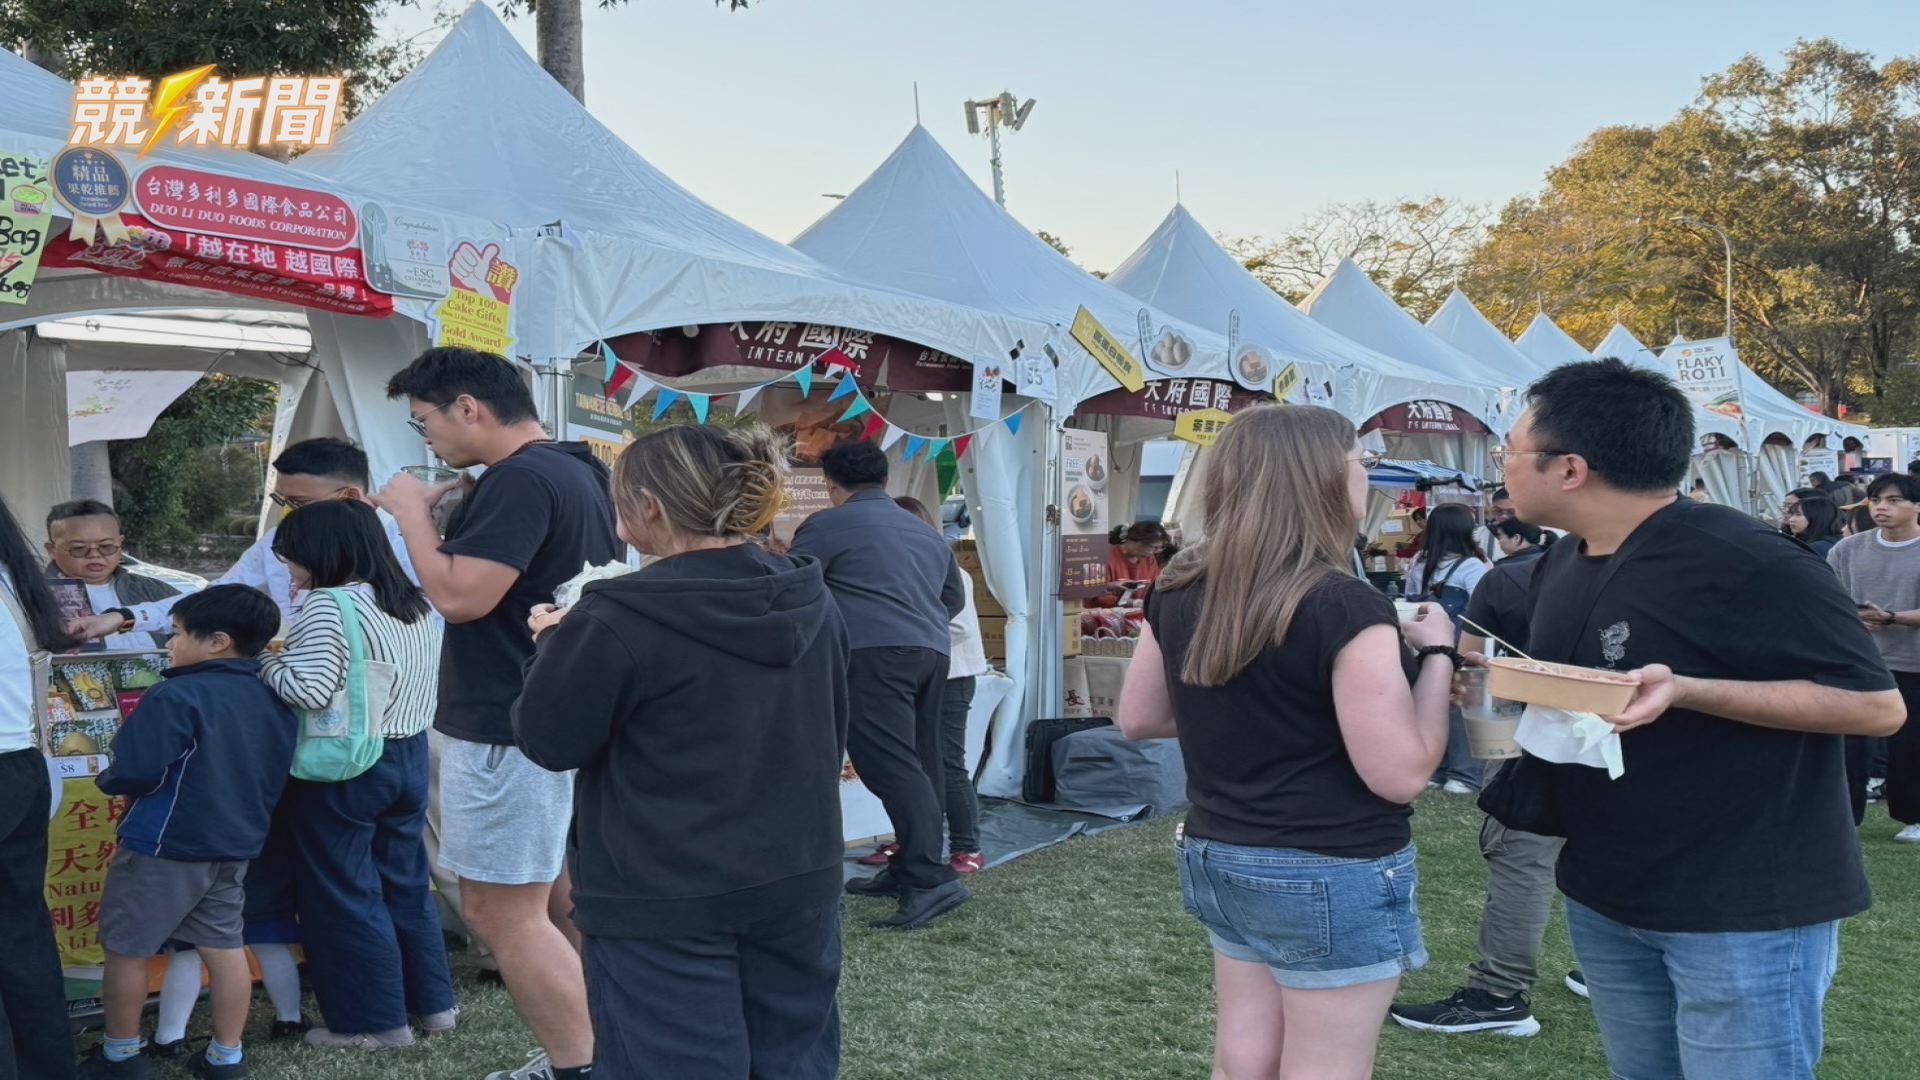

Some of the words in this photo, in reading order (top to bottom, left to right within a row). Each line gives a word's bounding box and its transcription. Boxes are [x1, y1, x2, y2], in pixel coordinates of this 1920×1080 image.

[72, 165, 110, 182] 精品
[146, 176, 348, 226] 台灣多利多國際食品公司
[150, 203, 177, 217] DUO
[181, 207, 193, 218] LI
[198, 210, 225, 223] DUO
[229, 214, 266, 229] FOODS
[270, 221, 347, 241] CORPORATION
[455, 288, 476, 306] Top
[479, 297, 497, 310] 100
[447, 299, 474, 315] Cake
[476, 308, 503, 325] Gifts
[442, 324, 467, 338] Gold
[471, 331, 502, 348] Award
[1677, 354, 1724, 369] FLAKY
[1680, 366, 1725, 381] ROTI
[60, 764, 75, 773] $8
